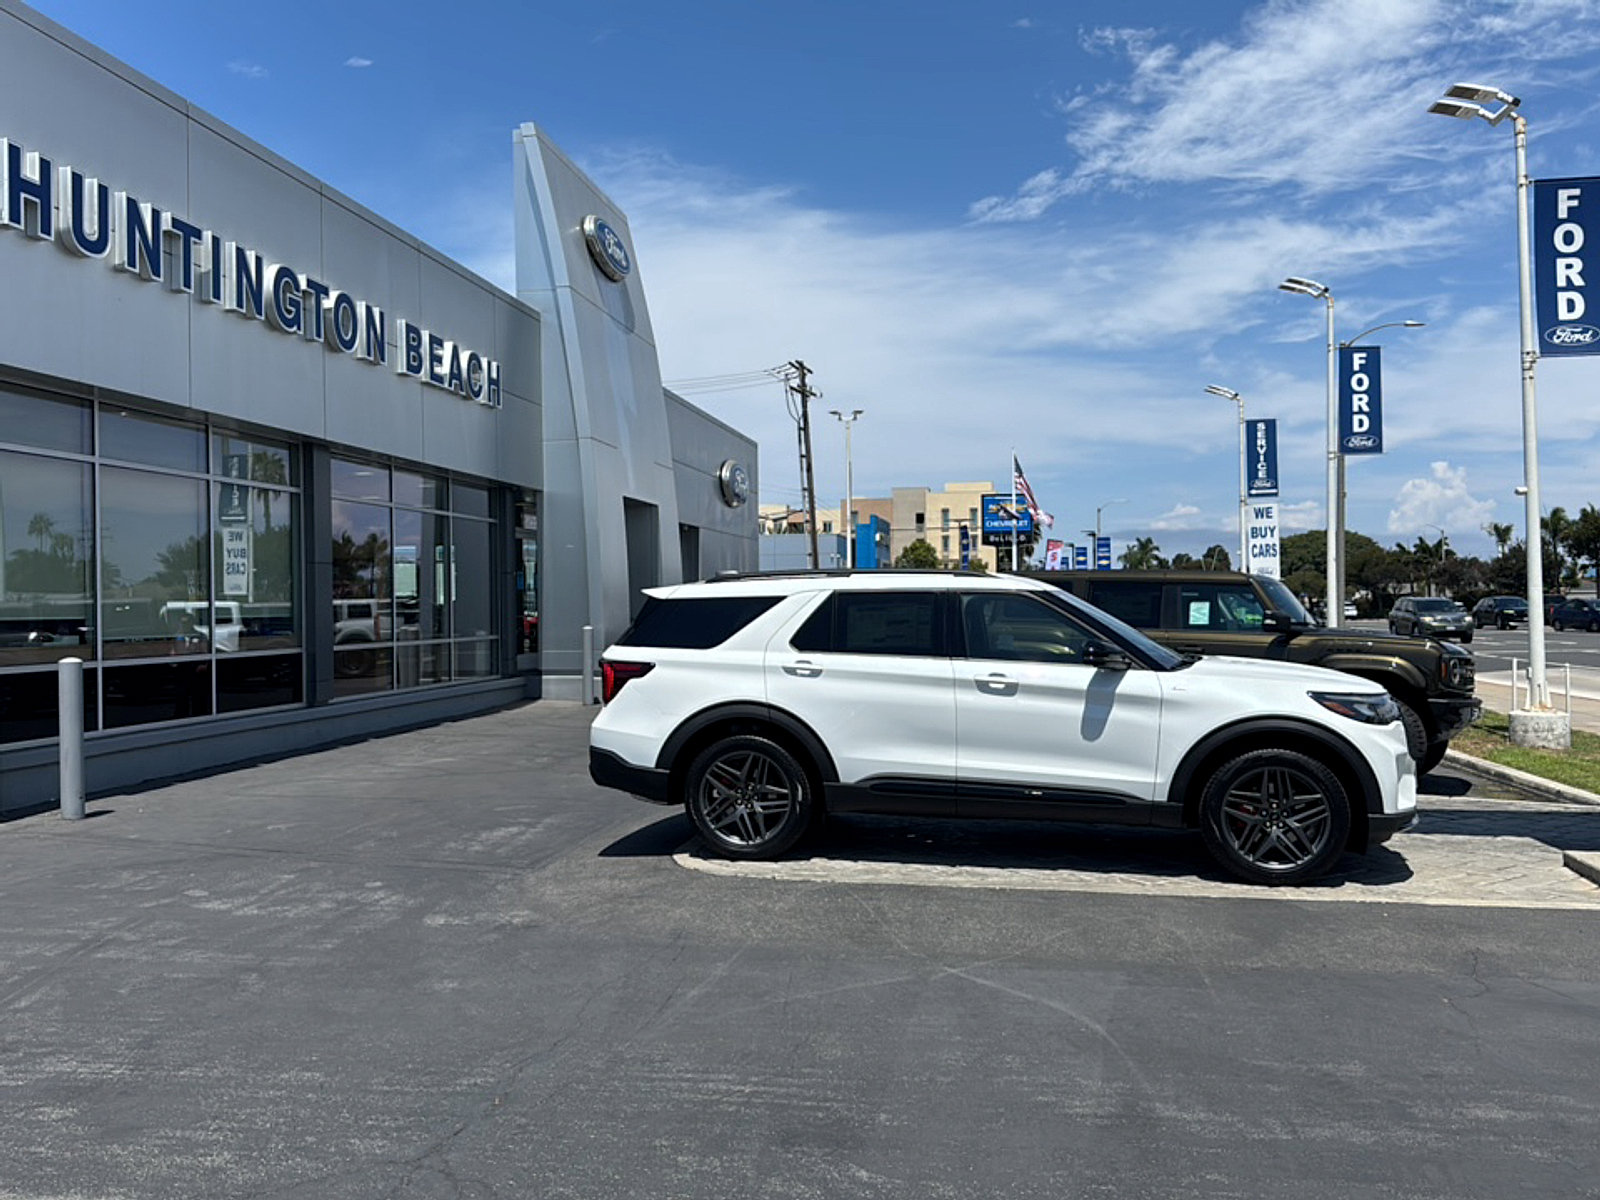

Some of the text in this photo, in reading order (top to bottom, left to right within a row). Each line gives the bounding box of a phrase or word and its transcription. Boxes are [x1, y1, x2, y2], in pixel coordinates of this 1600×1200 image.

[1554, 188, 1586, 321] FORD
[0, 137, 502, 409] HUNTINGTON BEACH
[1553, 327, 1593, 344] Ford
[1350, 352, 1370, 433] FORD
[1256, 421, 1268, 478] SERVICE
[1348, 437, 1374, 448] Ford
[1253, 506, 1273, 519] WE
[1251, 526, 1277, 539] BUY
[1251, 543, 1278, 558] CARS
